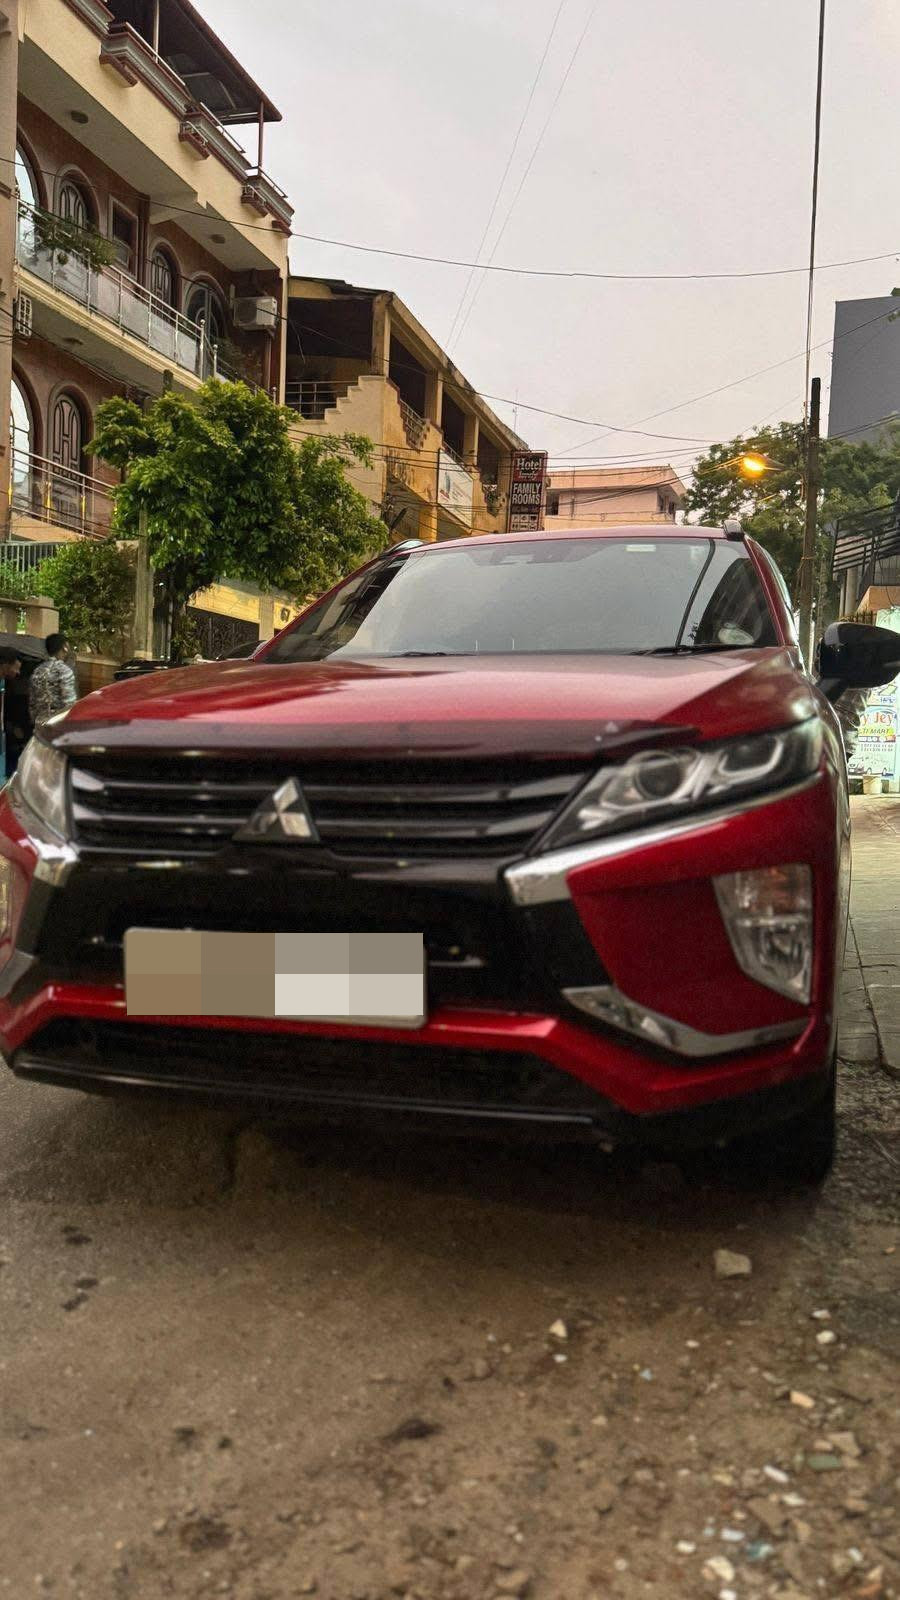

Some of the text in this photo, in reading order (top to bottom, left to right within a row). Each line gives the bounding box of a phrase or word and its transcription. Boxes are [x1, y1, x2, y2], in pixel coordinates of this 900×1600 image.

[516, 458, 542, 470] Hotel
[513, 482, 541, 494] FAMILY
[512, 494, 541, 504] ROOMS
